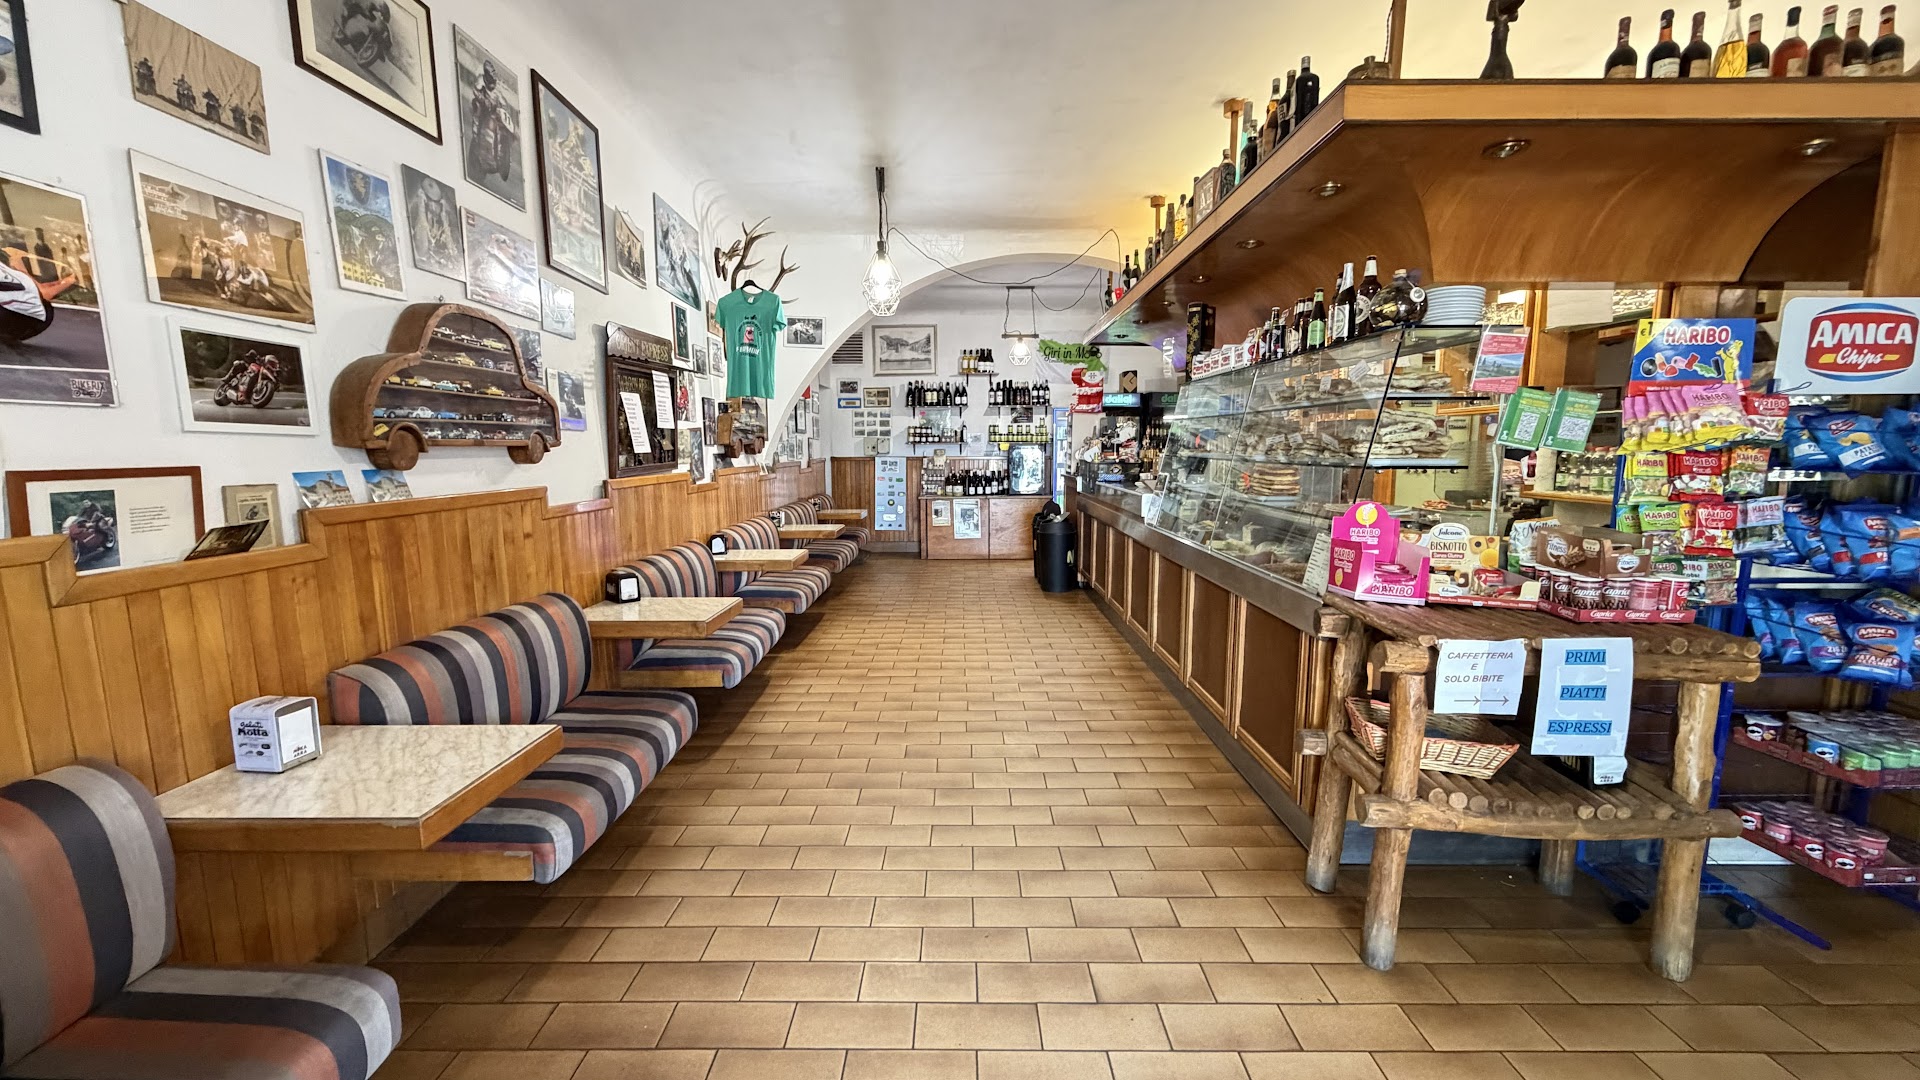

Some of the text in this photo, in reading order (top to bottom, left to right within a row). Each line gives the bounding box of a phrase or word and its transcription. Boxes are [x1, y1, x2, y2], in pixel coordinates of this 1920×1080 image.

[1664, 326, 1731, 345] HARIBO
[1810, 320, 1913, 348] AMICA
[641, 341, 668, 361] EXPRESS
[1043, 346, 1060, 361] Giri
[1063, 347, 1072, 358] in
[1837, 347, 1883, 369] Chips
[1692, 392, 1729, 402] HARIBO
[1683, 456, 1719, 467] HARIBO
[1737, 453, 1765, 462] HARIBO
[1636, 459, 1664, 467] HARIBO
[1752, 503, 1780, 513] HARIBO
[1644, 510, 1677, 519] HARIBO
[1350, 528, 1380, 536] HARIBO
[1430, 541, 1467, 551] BISKOTTO
[1334, 547, 1355, 561] HARIBO
[1372, 583, 1414, 596] HARIBO
[1572, 586, 1601, 597] Caprice
[1590, 610, 1616, 619] Caprice
[1625, 610, 1651, 619] Caprice
[1659, 611, 1686, 619] Caprice
[1447, 652, 1514, 660] CAFFETTERIA
[1565, 650, 1606, 663] PRIMI
[1444, 674, 1504, 683] SOLO BIBITE
[1560, 686, 1607, 699] PIATTI
[1547, 720, 1612, 734] ESPRESSI
